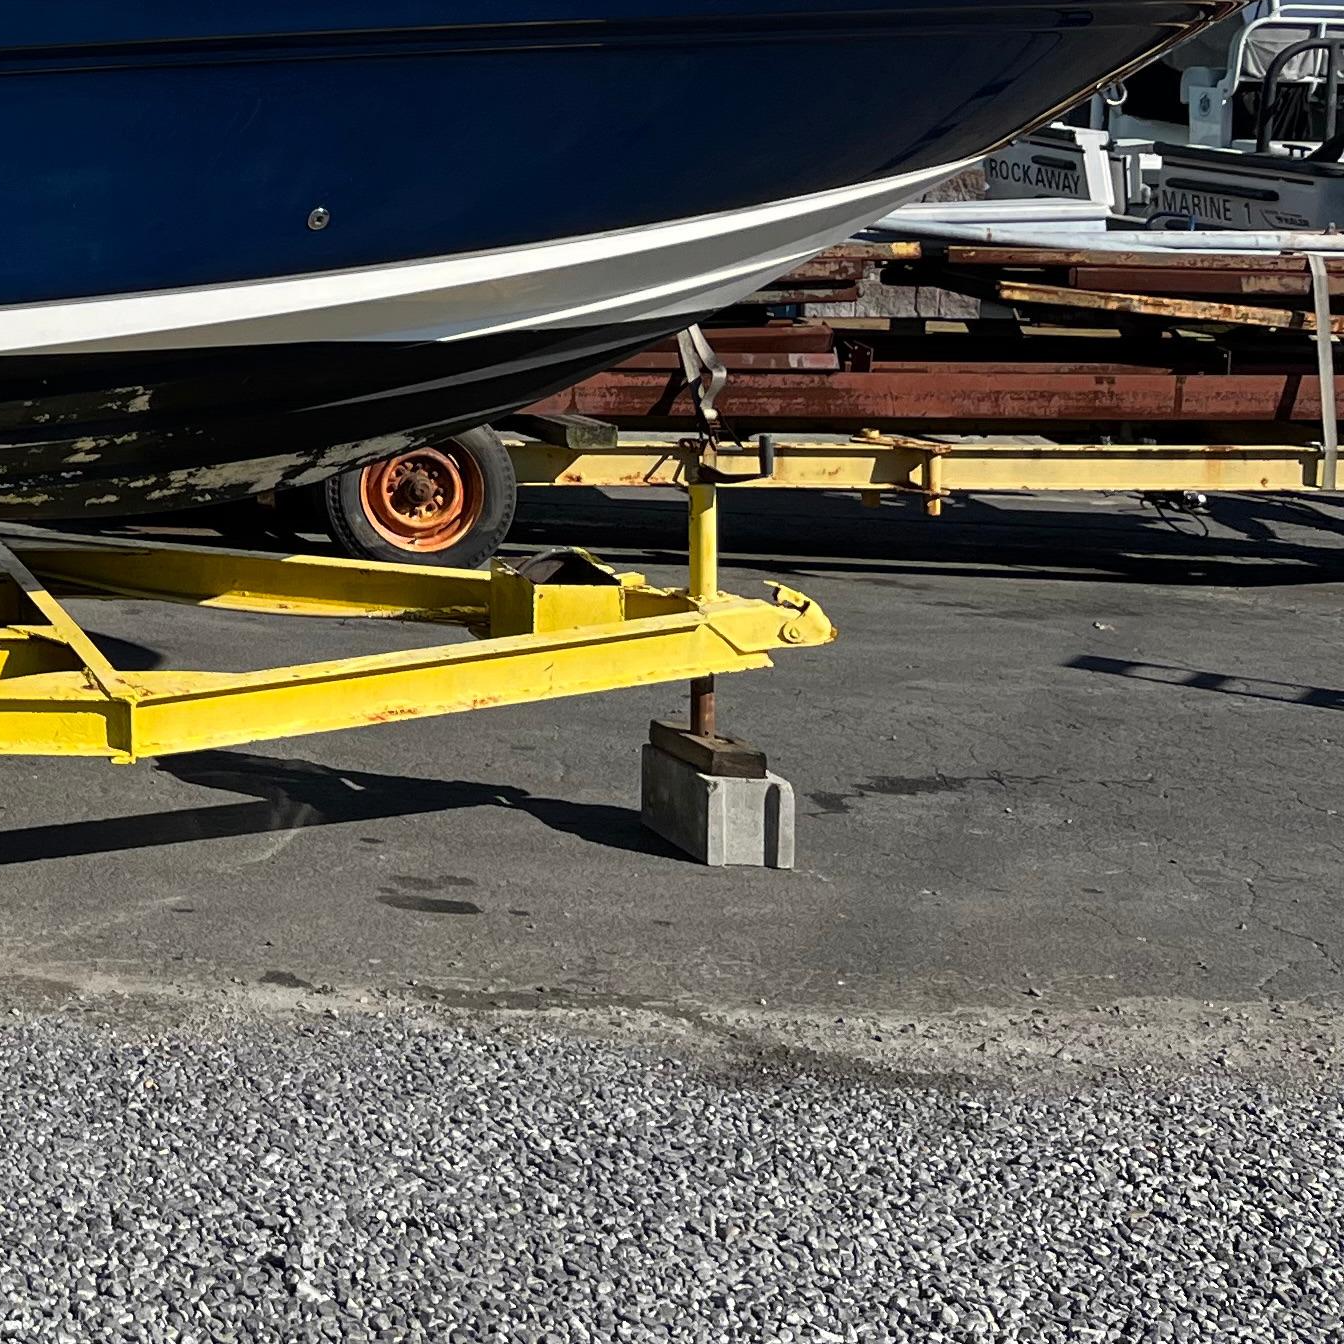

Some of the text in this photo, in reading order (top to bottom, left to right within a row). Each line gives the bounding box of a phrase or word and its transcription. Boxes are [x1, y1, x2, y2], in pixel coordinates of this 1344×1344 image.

[989, 158, 1080, 195] ROCKAWAY
[1162, 189, 1251, 225] MARINE 1
